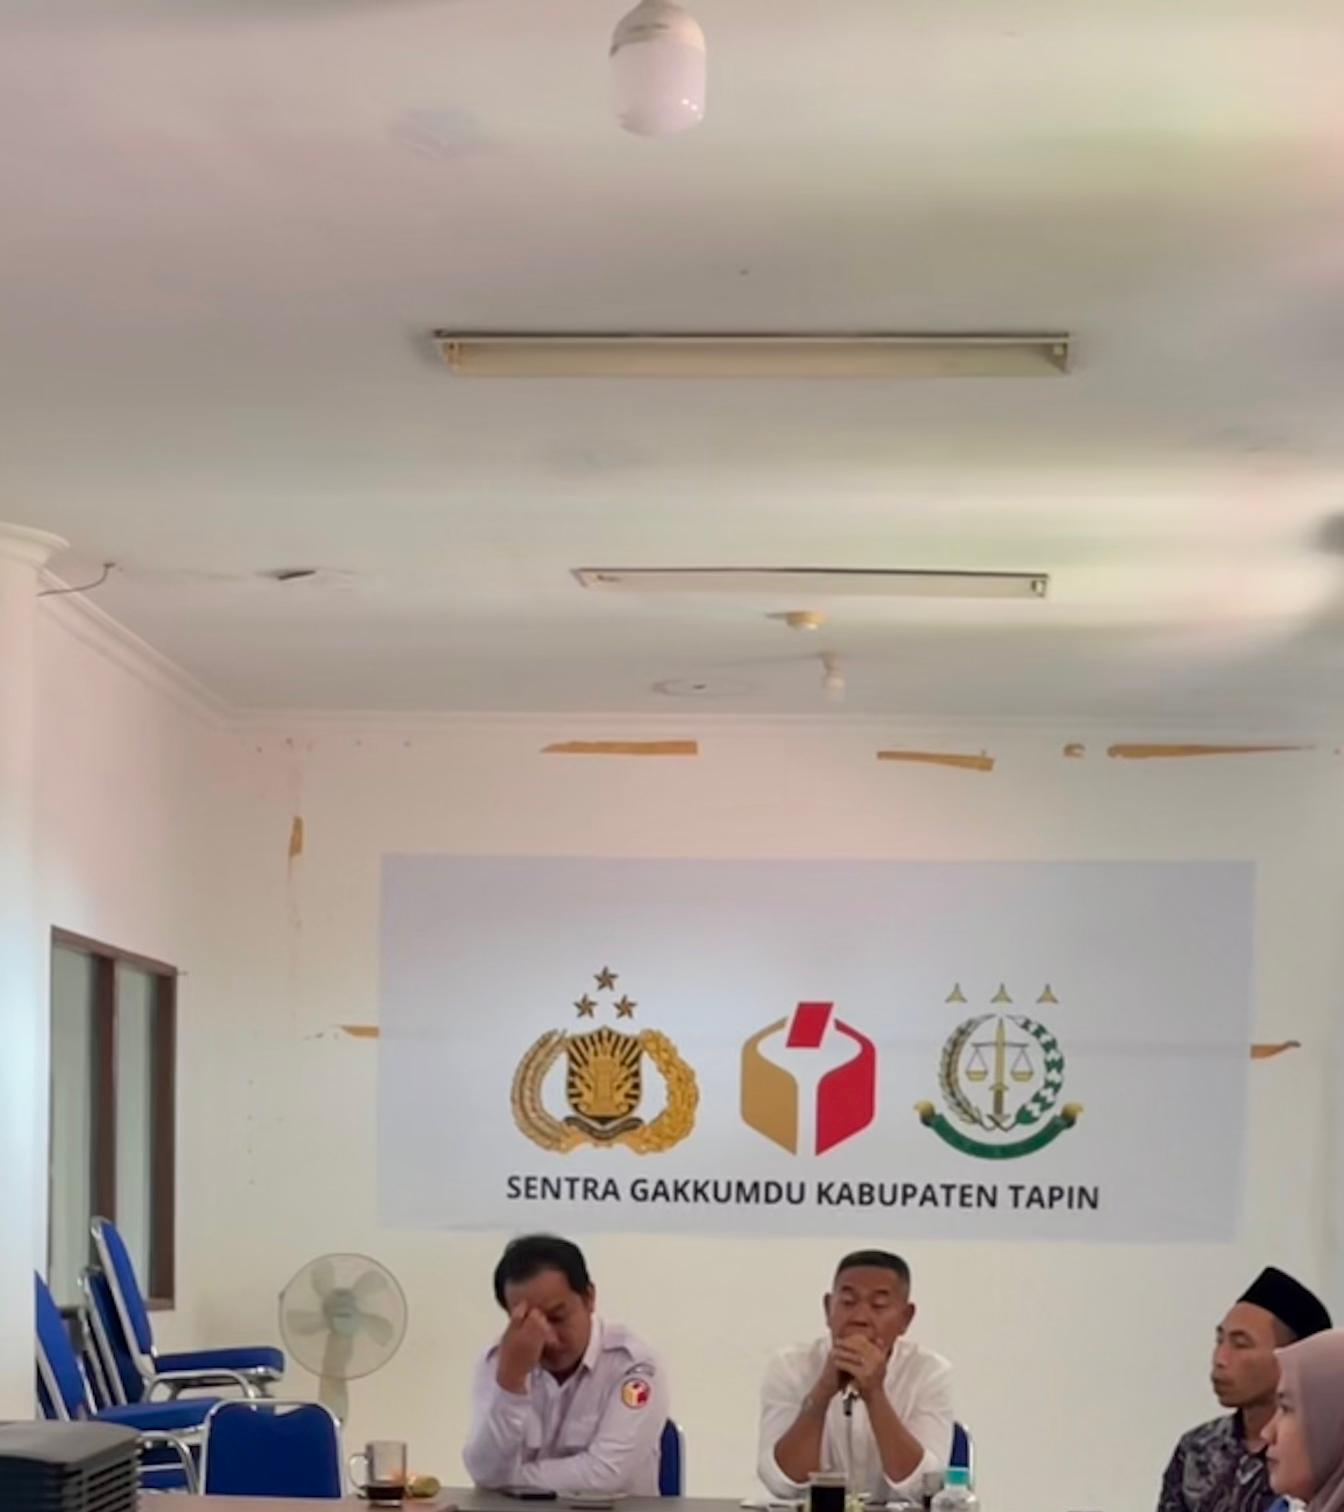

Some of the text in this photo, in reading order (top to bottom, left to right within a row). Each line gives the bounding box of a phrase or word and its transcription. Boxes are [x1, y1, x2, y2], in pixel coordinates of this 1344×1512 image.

[506, 1175, 1099, 1210] SENTRA GAKKUMDU KABUPATEN TAPIN
